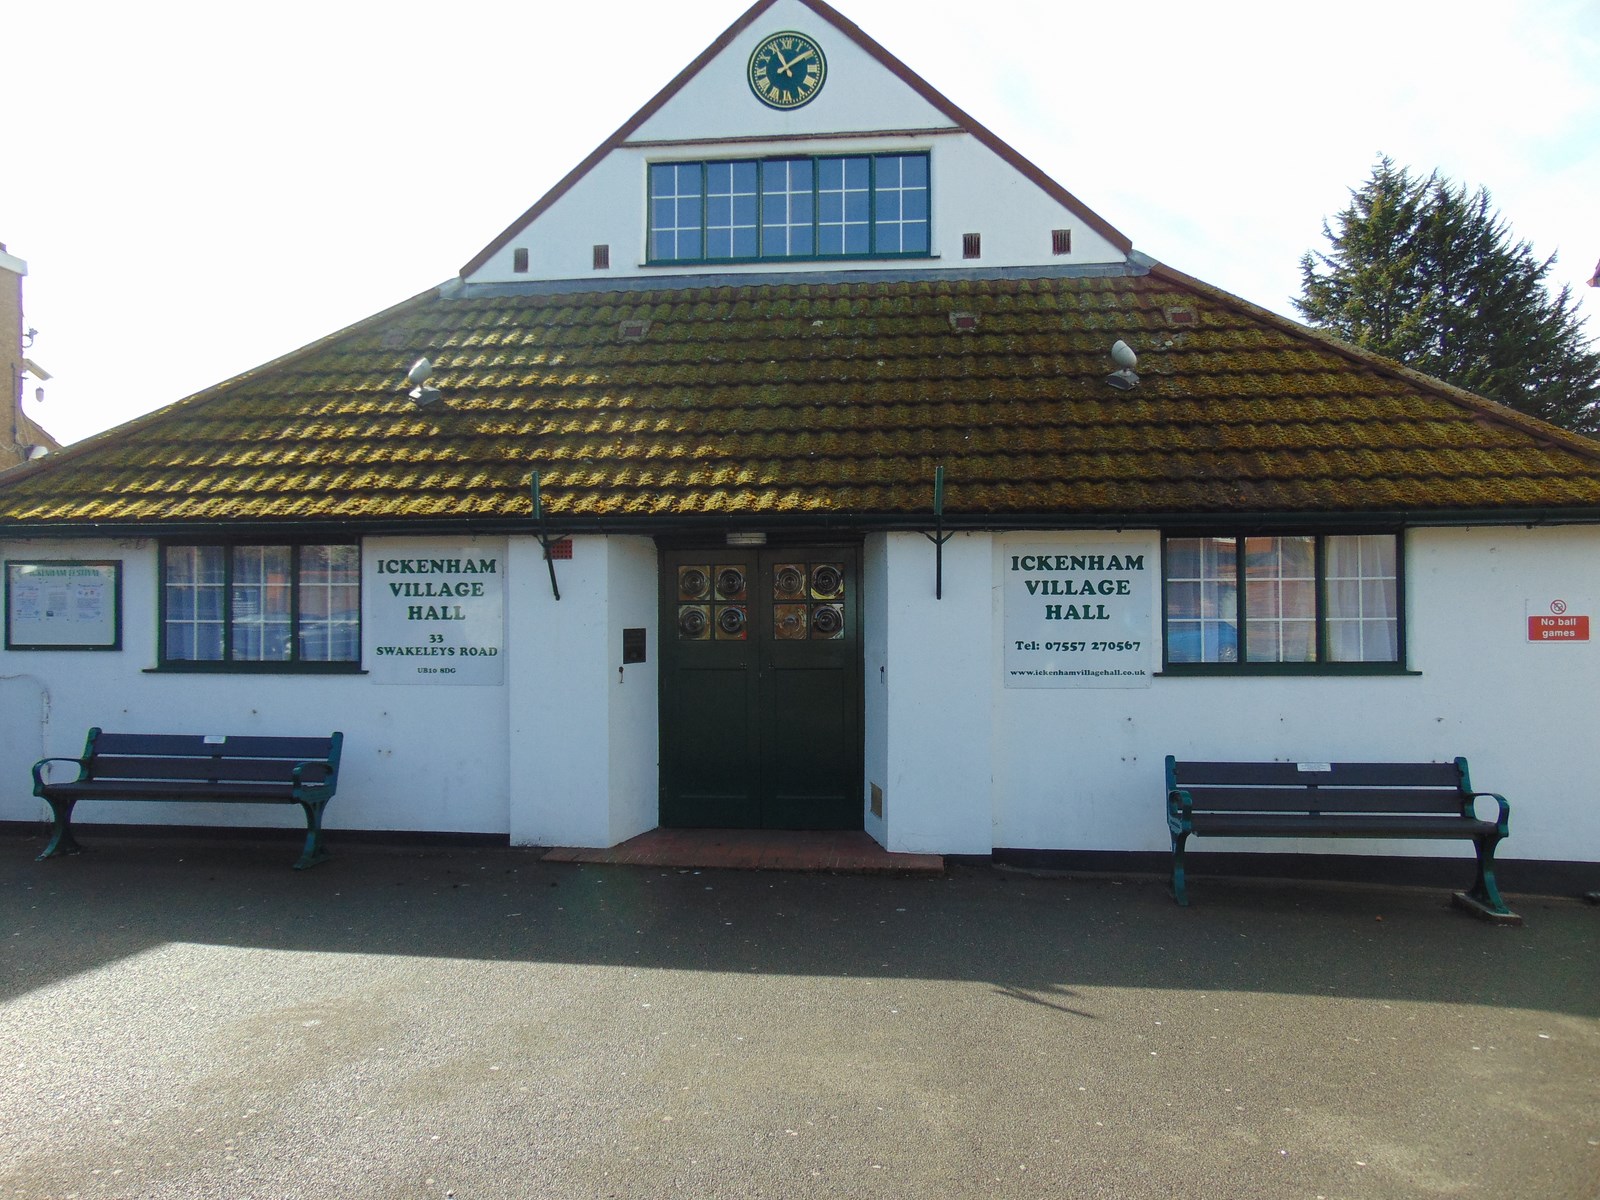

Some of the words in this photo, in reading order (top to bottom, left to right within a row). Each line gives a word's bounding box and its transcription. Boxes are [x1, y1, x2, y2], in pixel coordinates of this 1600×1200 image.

[377, 559, 497, 574] ICKENHAM
[1011, 555, 1144, 571] ICKENHAM
[389, 583, 484, 597] VILLAGE
[1025, 579, 1131, 595] VILLAGE
[408, 605, 466, 620] HALL
[1045, 604, 1110, 620] HALL
[1541, 618, 1555, 626] No
[1558, 618, 1576, 626] ball
[429, 634, 444, 644] 33
[1542, 630, 1576, 639] games
[376, 646, 455, 656] SWAKELEYS
[459, 647, 498, 657] ROAD
[1015, 641, 1040, 651] Tel:
[1045, 641, 1086, 652] 07557
[1091, 641, 1141, 652] 270567
